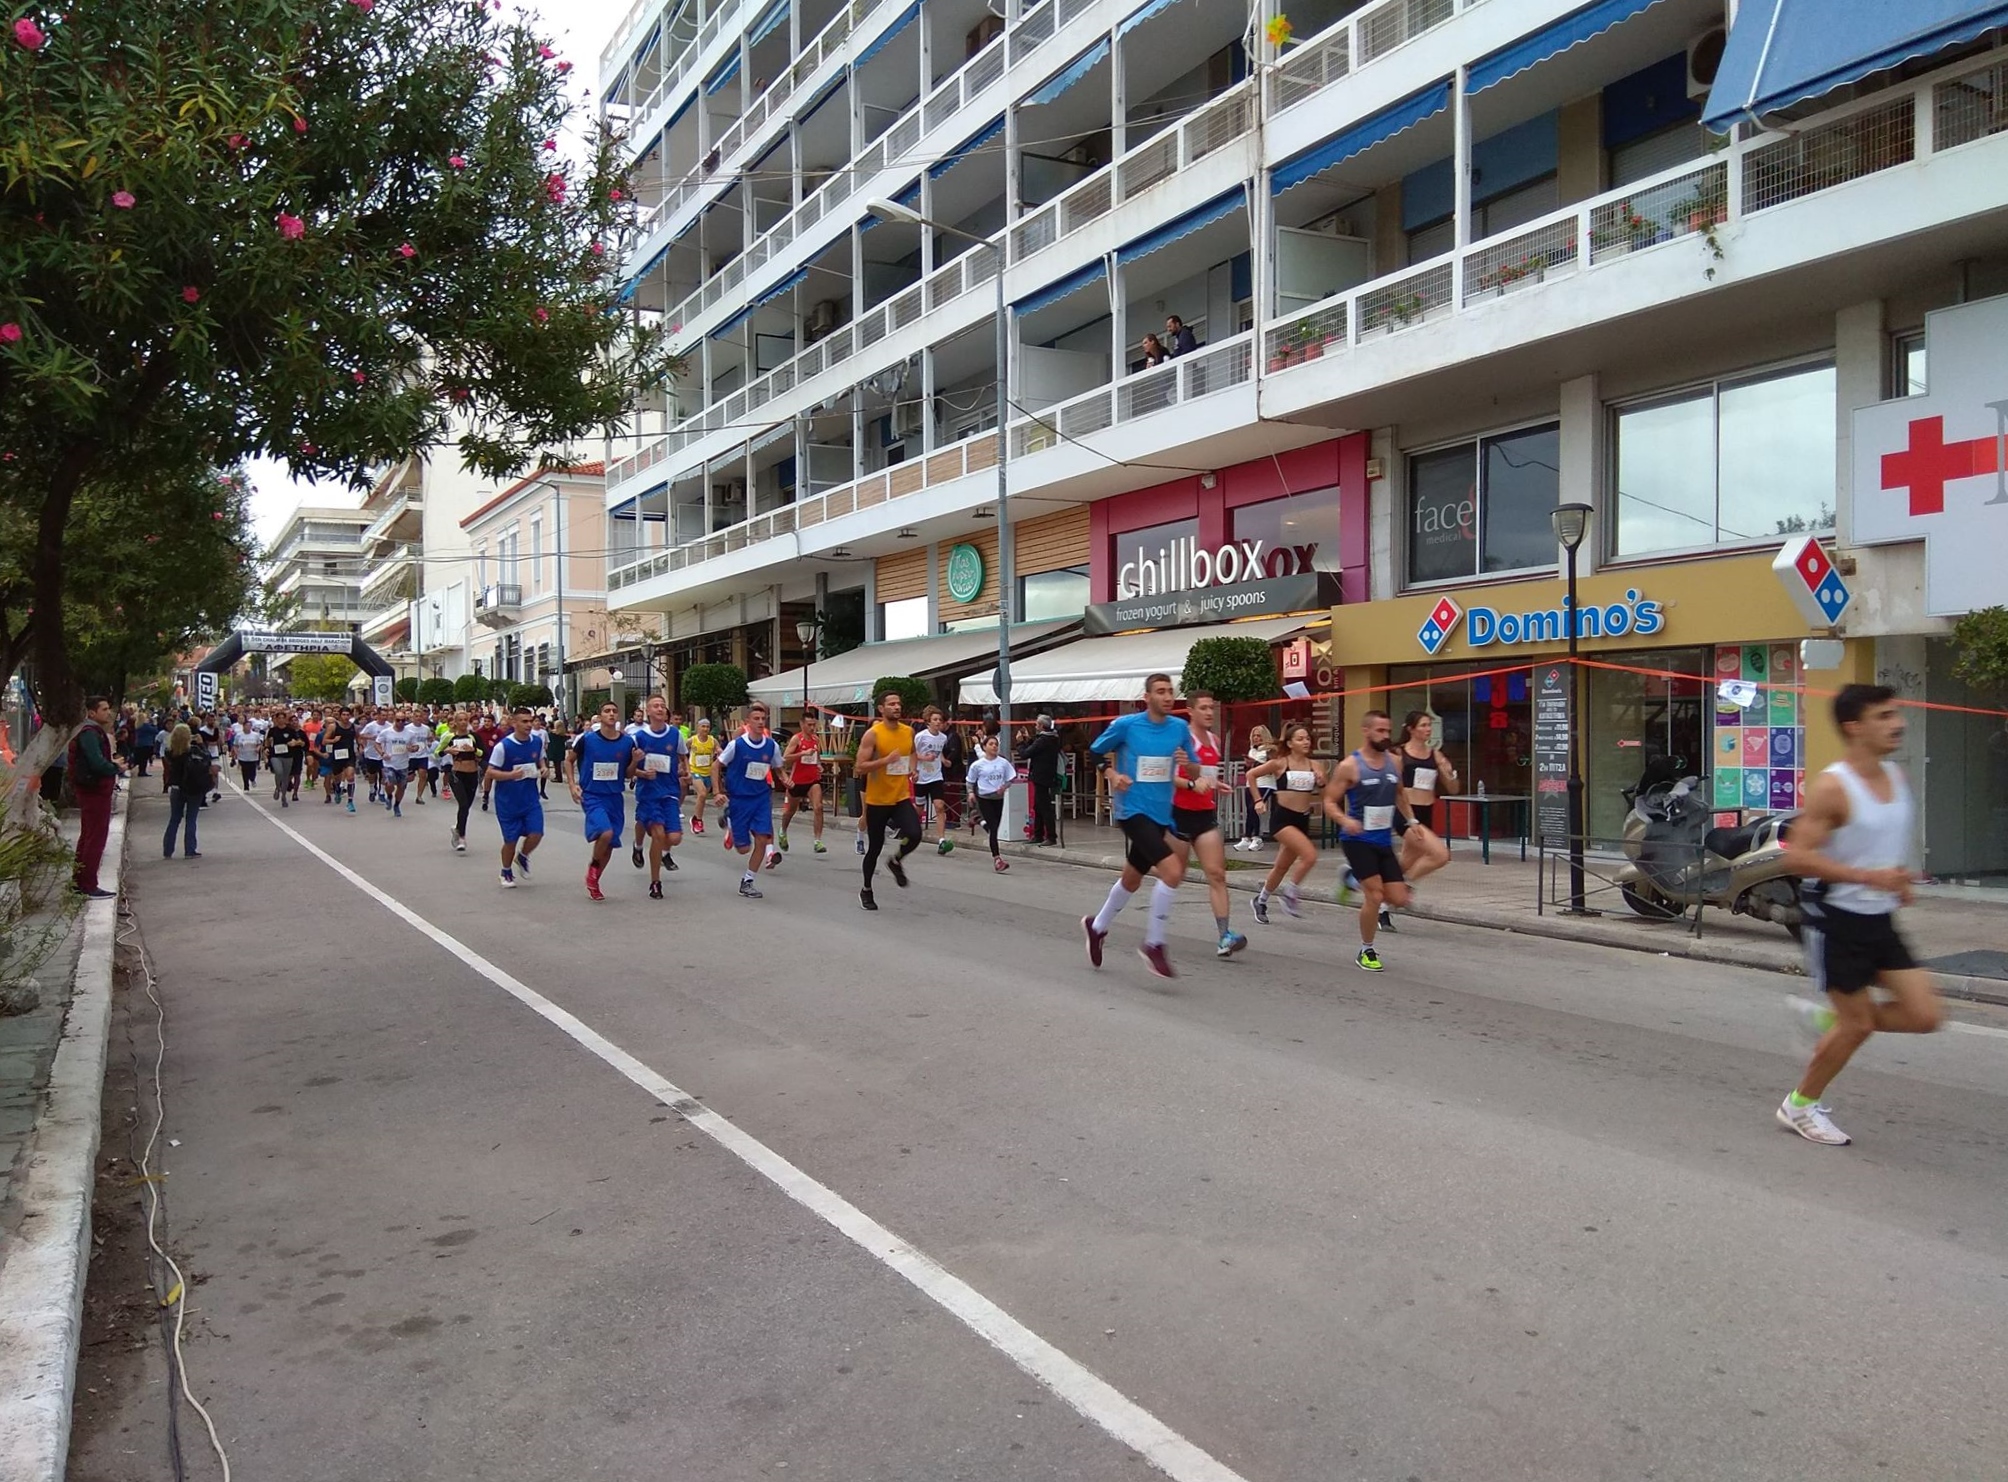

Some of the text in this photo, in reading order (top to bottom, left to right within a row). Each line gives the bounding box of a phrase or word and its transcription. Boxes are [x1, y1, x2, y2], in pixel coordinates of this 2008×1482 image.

[1414, 495, 1474, 534] face
[1426, 530, 1462, 546] medical
[1118, 535, 1264, 598] chillbox
[1116, 590, 1266, 622] frozen yogurt & juicy spoons
[1466, 588, 1664, 647] Domino's
[264, 644, 330, 652] ΑΦΕΤΗΡΙΑ
